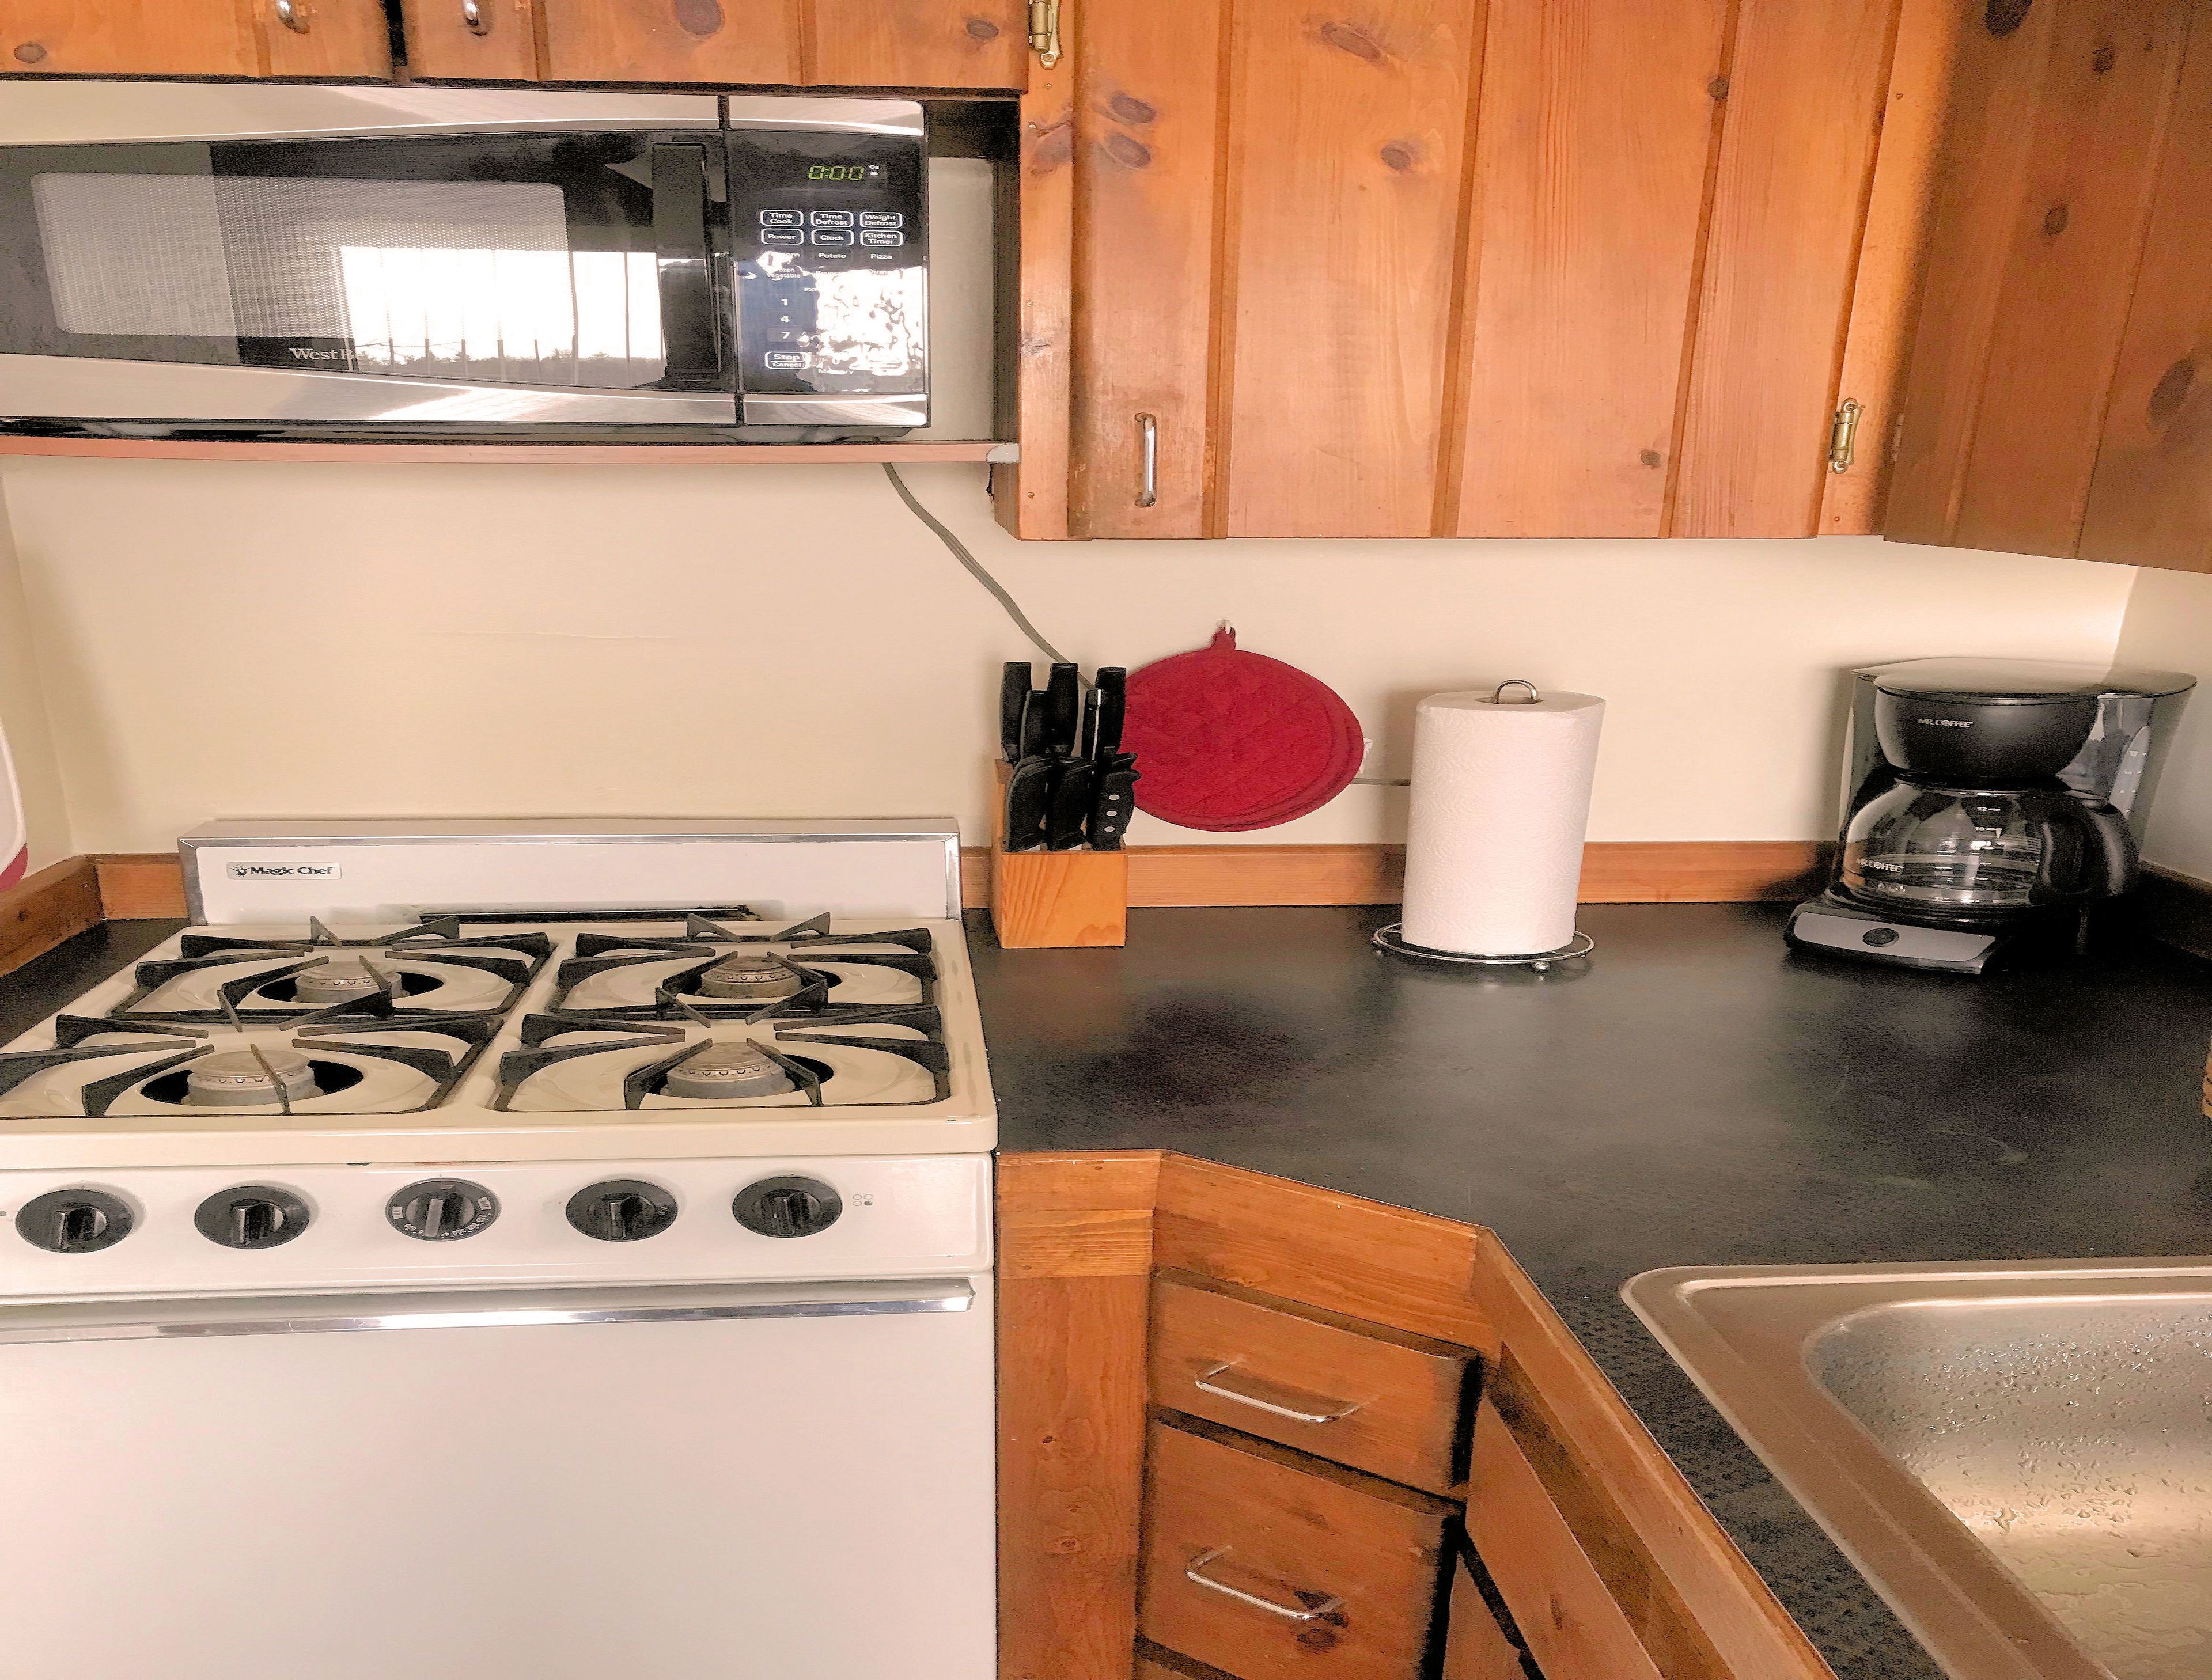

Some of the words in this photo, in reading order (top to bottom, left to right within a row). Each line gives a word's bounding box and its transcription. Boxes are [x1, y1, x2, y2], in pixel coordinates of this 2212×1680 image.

[781, 331, 790, 339] 7
[773, 353, 800, 361] Stop
[250, 867, 295, 876] Magic
[297, 867, 336, 875] Chef
